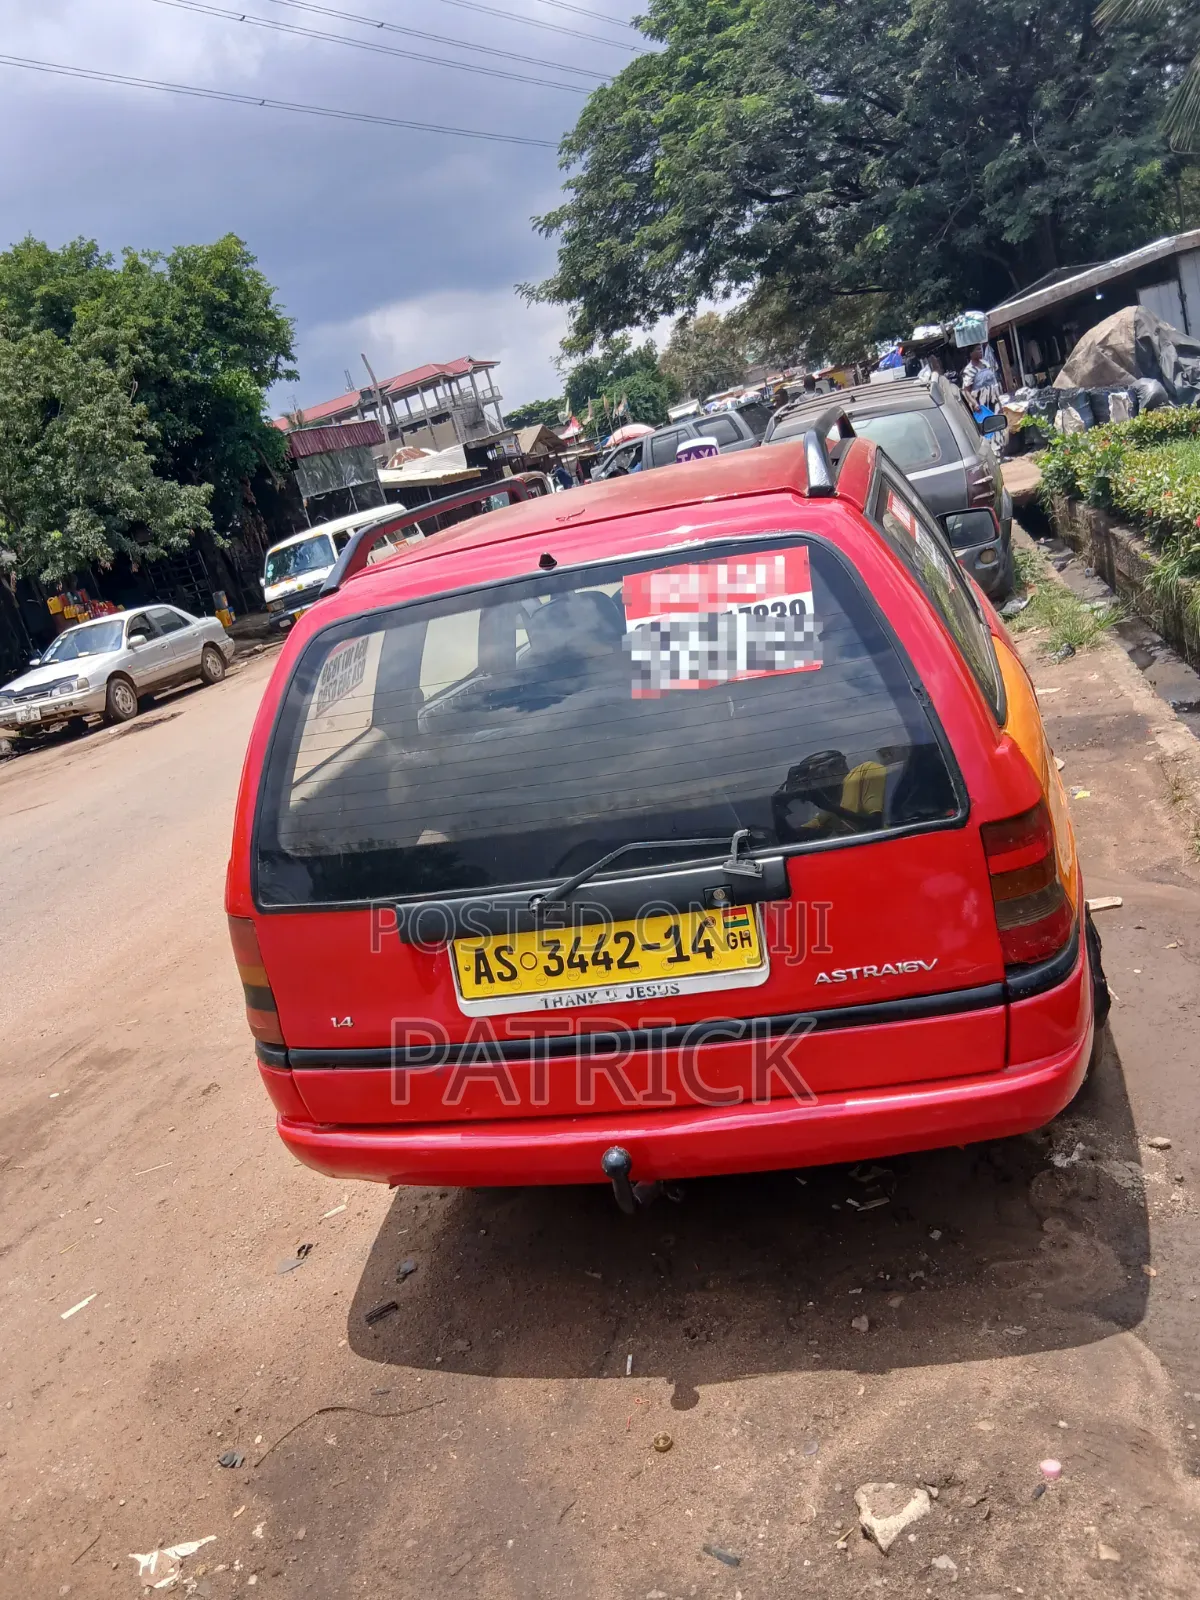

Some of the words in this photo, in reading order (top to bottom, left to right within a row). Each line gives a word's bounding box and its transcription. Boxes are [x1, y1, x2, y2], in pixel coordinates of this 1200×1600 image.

[726, 930, 753, 950] GH
[474, 947, 518, 985] AS
[541, 916, 715, 977] 3442-14
[625, 983, 681, 999] JESUS
